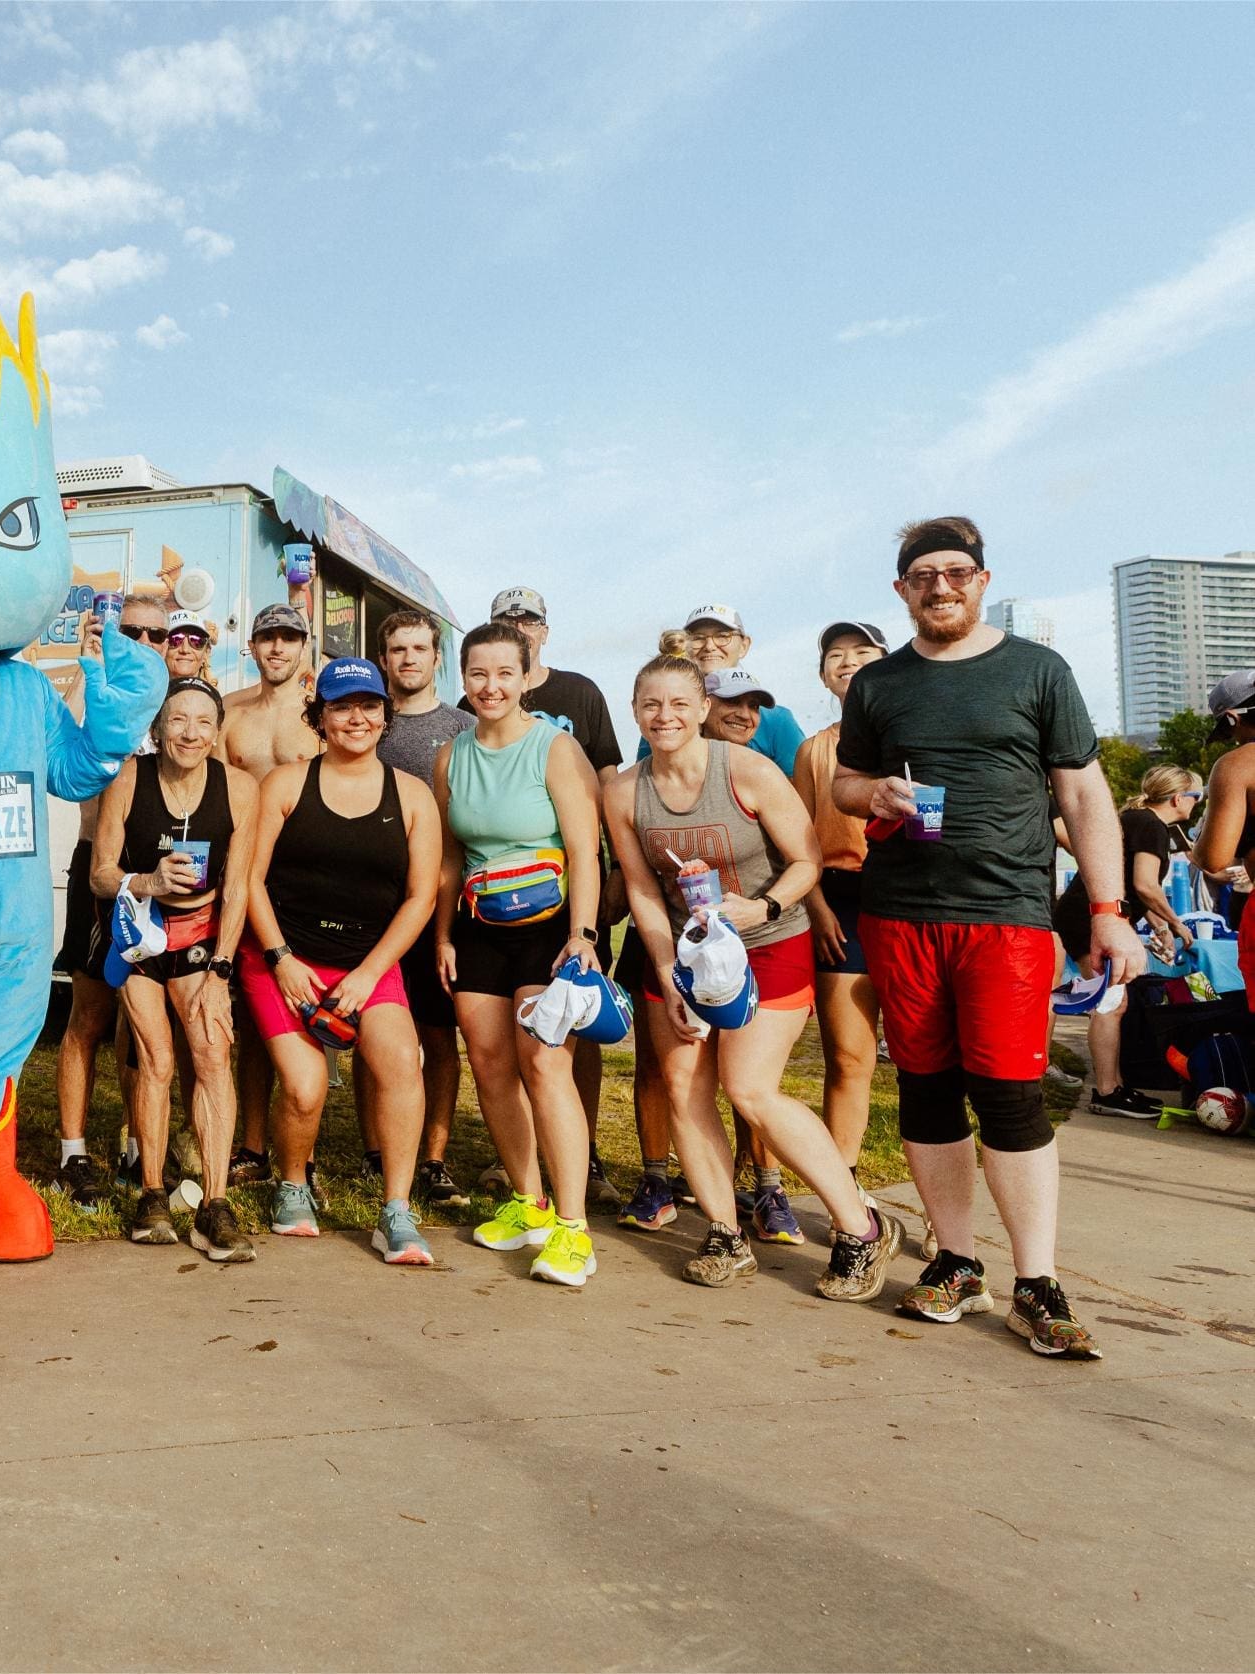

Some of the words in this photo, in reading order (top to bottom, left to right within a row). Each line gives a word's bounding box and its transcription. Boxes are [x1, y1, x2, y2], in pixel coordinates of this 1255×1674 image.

[294, 553, 311, 562] KON
[504, 590, 523, 600] ATX
[695, 606, 714, 616] ATX
[171, 613, 188, 621] ATX
[325, 608, 355, 626] DELICIOUS
[731, 671, 751, 679] ATX
[119, 919, 134, 945] AUSTIN
